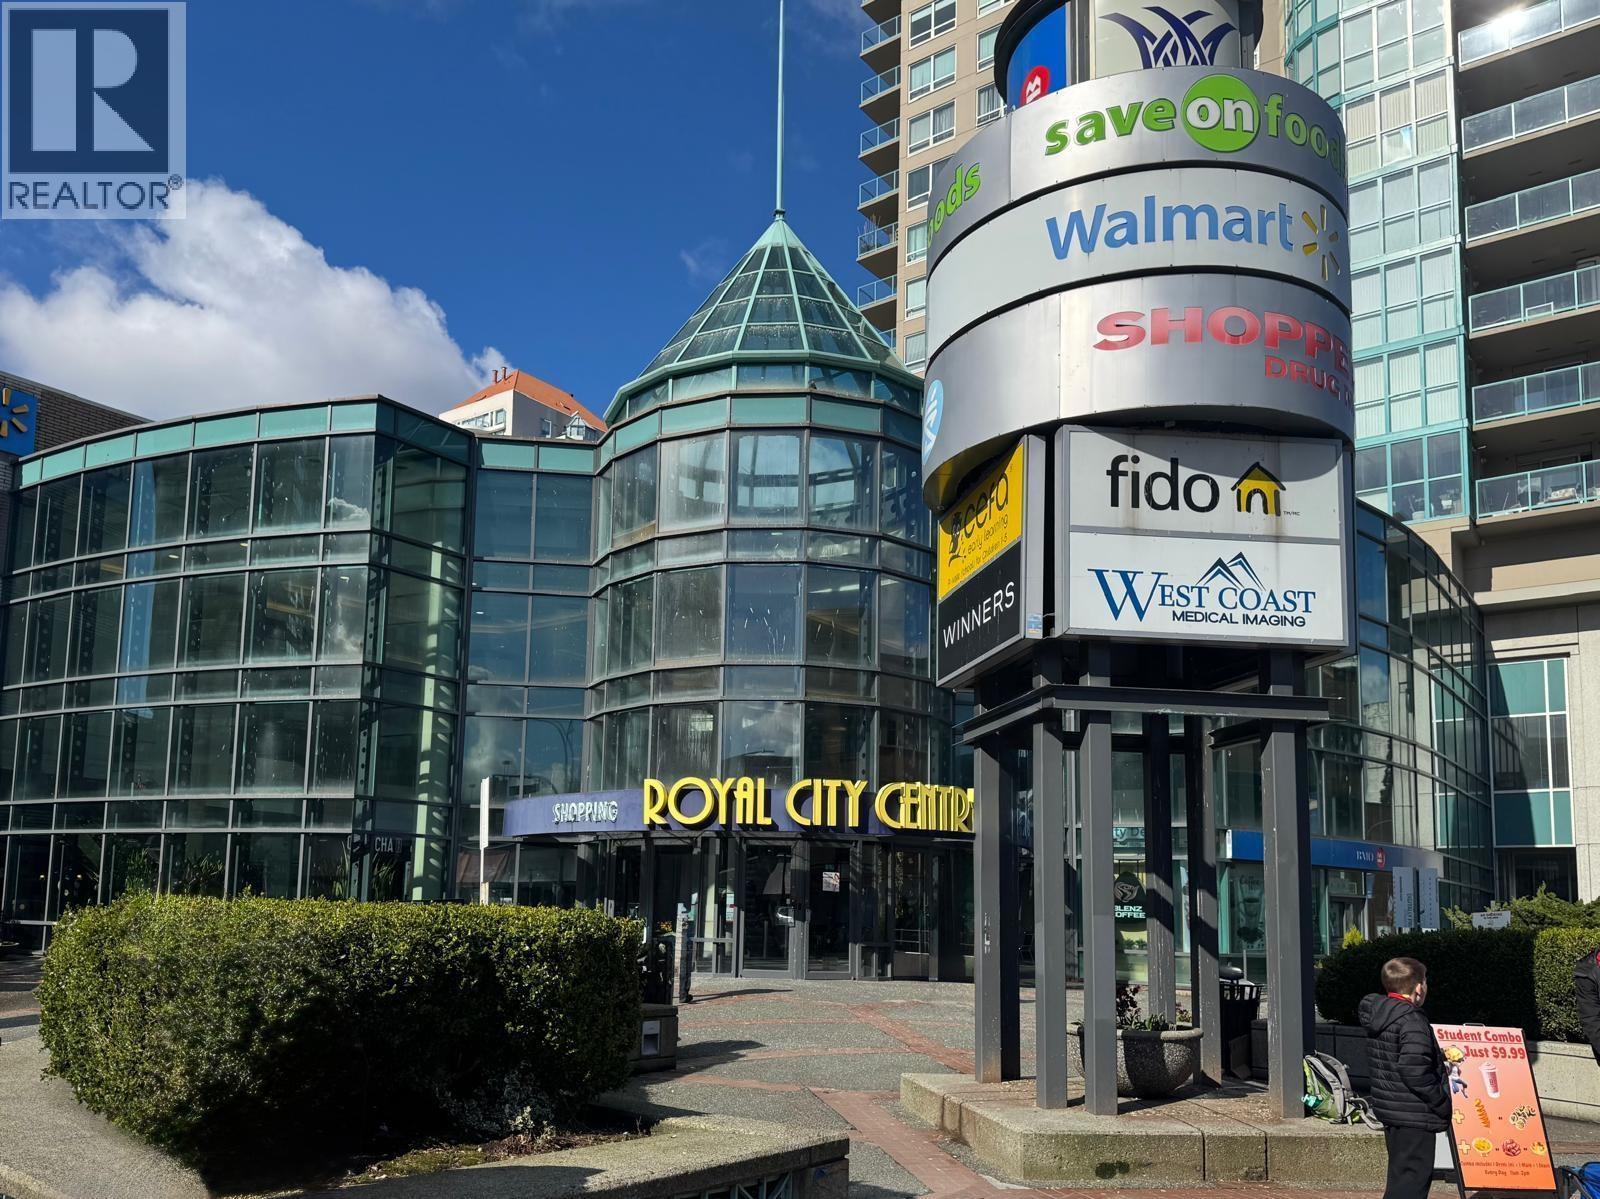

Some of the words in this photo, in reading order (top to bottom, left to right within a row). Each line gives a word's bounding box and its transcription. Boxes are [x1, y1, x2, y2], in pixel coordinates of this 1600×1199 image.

[1044, 98, 1176, 156] save
[1185, 95, 1256, 132] on
[1045, 195, 1294, 260] Walmart
[1106, 454, 1220, 512] fido
[984, 514, 1008, 542] learning
[943, 581, 1015, 648] WINNERS
[1088, 568, 1211, 622] WEST
[1219, 585, 1316, 614] COAST
[1172, 610, 1239, 625] MEDICAL
[1242, 612, 1306, 628] IMAGING
[551, 799, 619, 824] SHOPPING
[643, 777, 772, 826] ROYAL
[785, 778, 868, 828] CITY
[1437, 1029, 1482, 1041] Student
[1484, 1031, 1522, 1043] Combo
[1464, 1045, 1490, 1058] Just
[1491, 1046, 1526, 1060] $9.99
